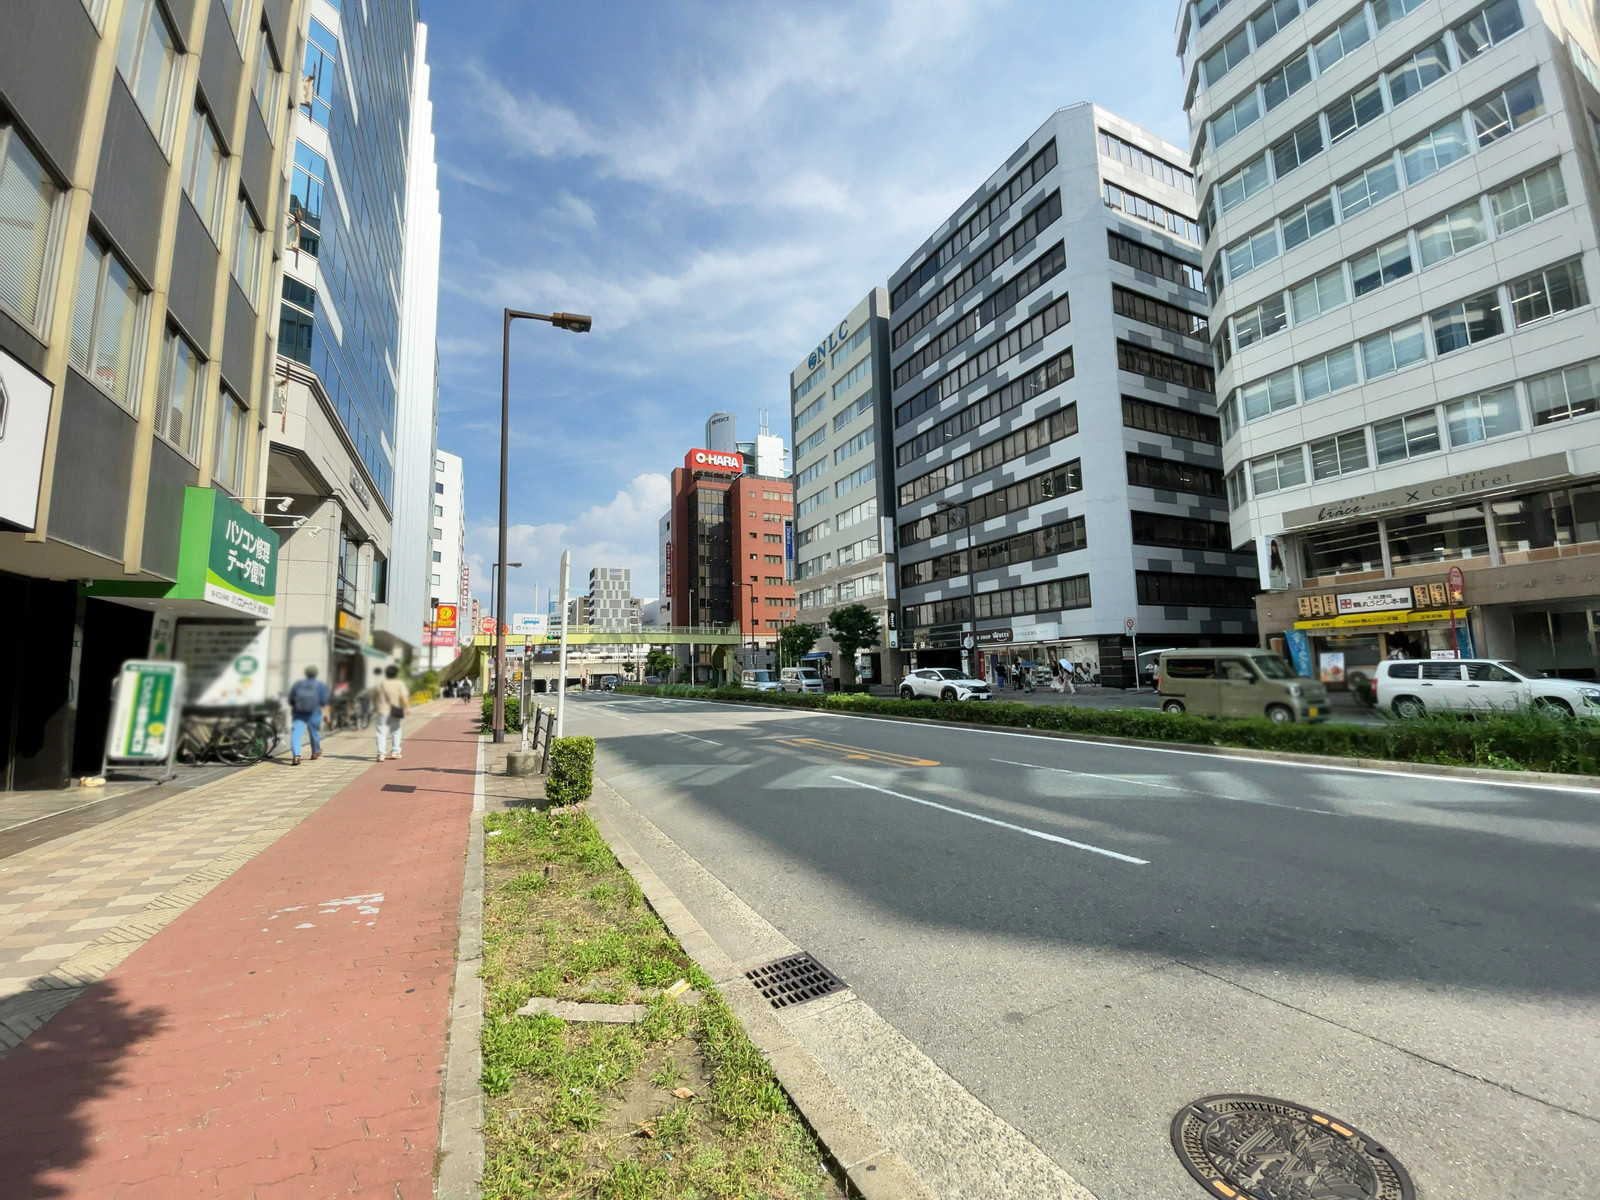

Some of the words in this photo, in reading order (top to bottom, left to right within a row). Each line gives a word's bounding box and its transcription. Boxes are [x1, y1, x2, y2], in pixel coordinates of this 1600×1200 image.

[711, 416, 730, 425] KEYENCE
[1431, 473, 1514, 497] Coffret
[225, 519, 271, 564] パソコン修理
[227, 549, 266, 587] データ復旧
[992, 630, 1010, 640] Watts
